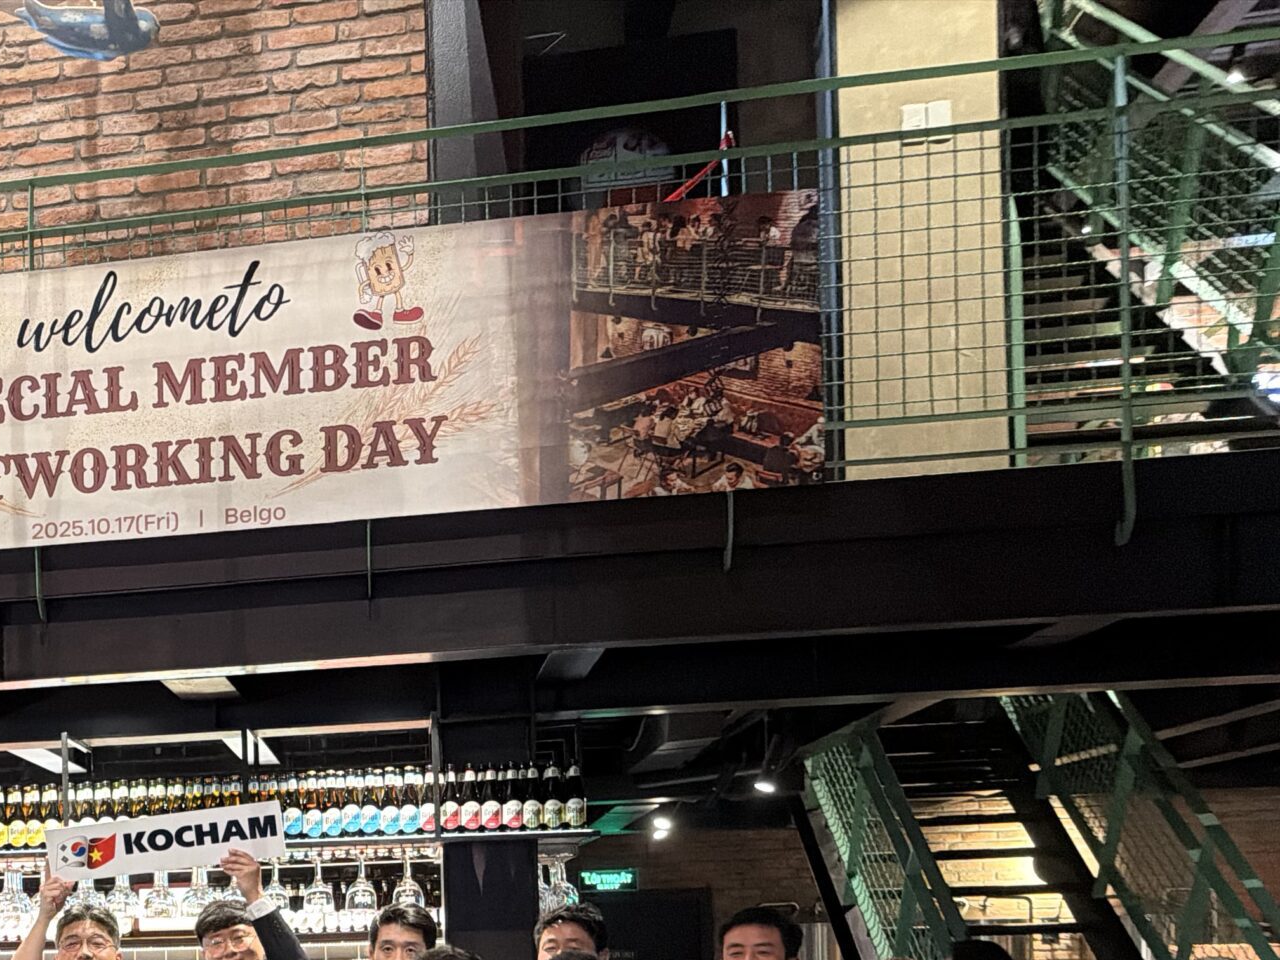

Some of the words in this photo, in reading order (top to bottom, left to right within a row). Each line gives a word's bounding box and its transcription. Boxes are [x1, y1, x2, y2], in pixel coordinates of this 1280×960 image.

[152, 335, 437, 408] MEMBER
[320, 415, 448, 473] DAY
[32, 511, 179, 540] 2025.10.17(Fri)
[224, 506, 287, 526] Belgo
[123, 815, 277, 855] KOCHAM
